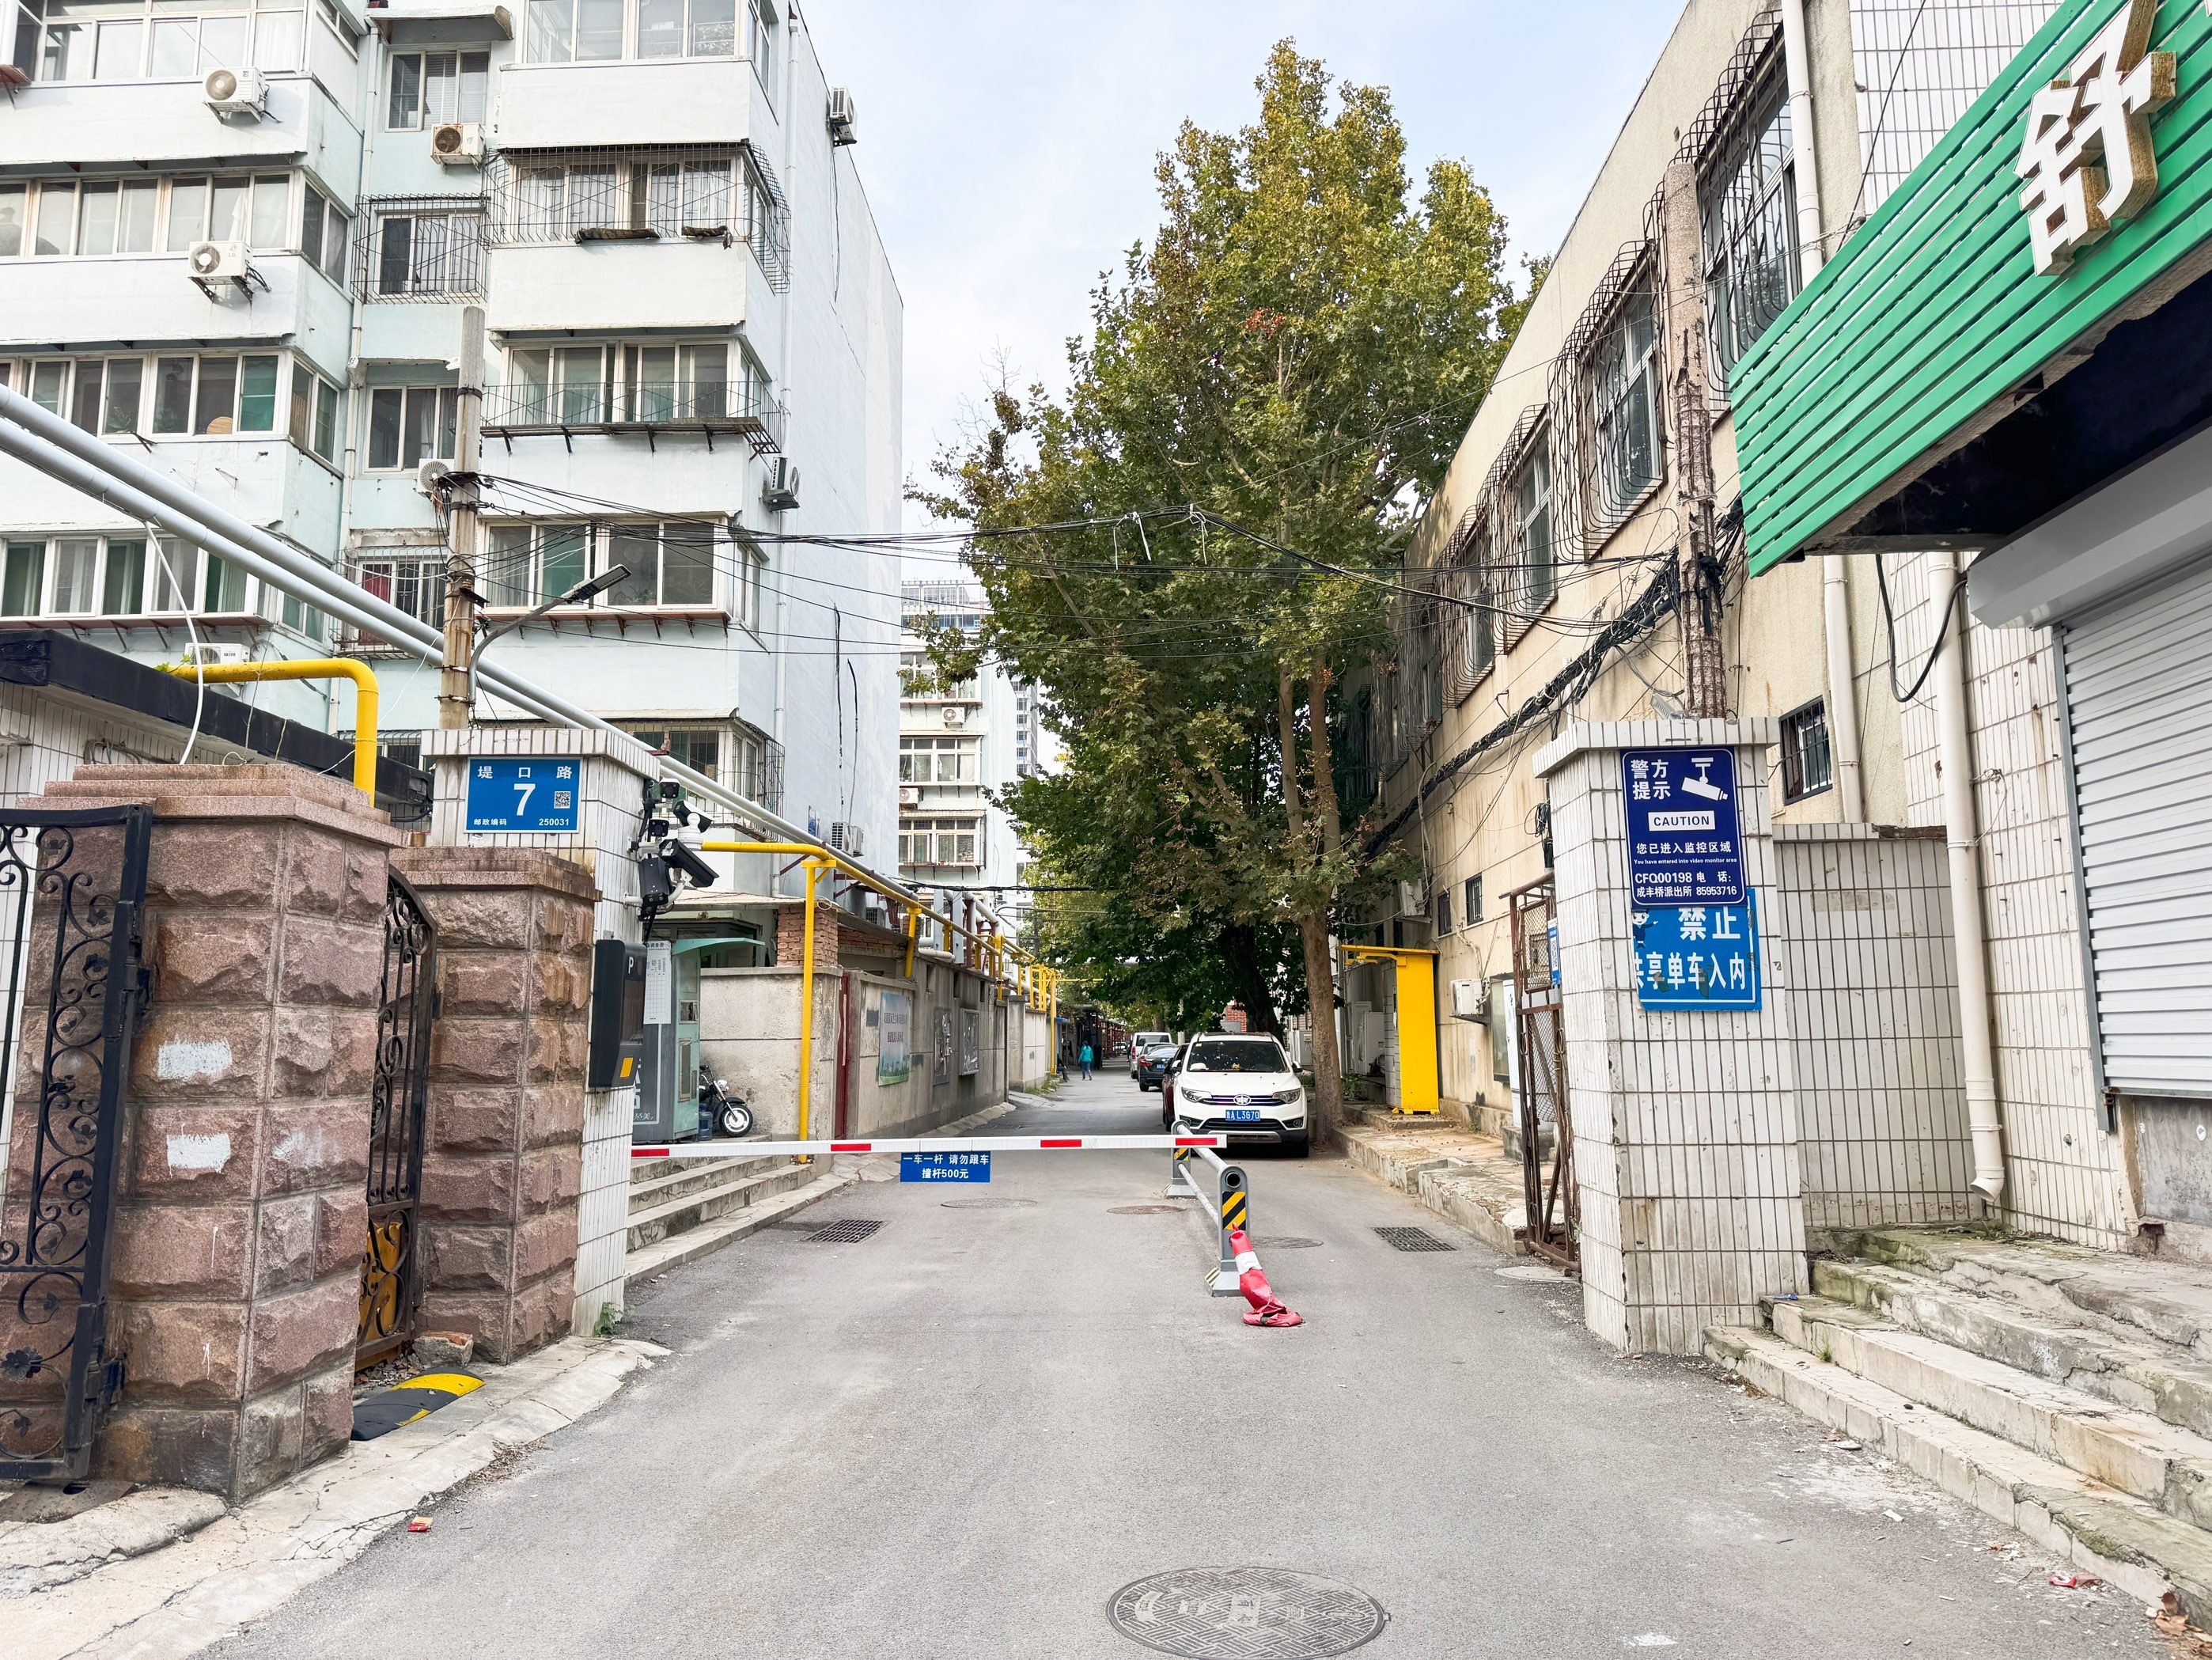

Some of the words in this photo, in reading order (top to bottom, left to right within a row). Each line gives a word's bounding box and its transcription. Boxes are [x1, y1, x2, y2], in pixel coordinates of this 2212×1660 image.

[2013, 0, 2176, 277] 舒
[477, 765, 573, 779] 堤口路
[1631, 759, 1668, 779] 警方
[1632, 781, 1671, 801] 提示
[513, 783, 536, 817] 7
[1653, 816, 1710, 827] CAUTION
[1636, 840, 1732, 855] 您已进入监控区域
[1634, 872, 1692, 884] CFQ00198
[1636, 885, 1692, 898] 成丰桥派出所
[1695, 885, 1737, 896] 85953716
[1678, 906, 1740, 941] 禁止
[628, 956, 634, 975] P
[903, 1154, 944, 1164] 一车一杆
[949, 1154, 989, 1165] 请勿跟车
[922, 1168, 969, 1179] 撞杆500元
